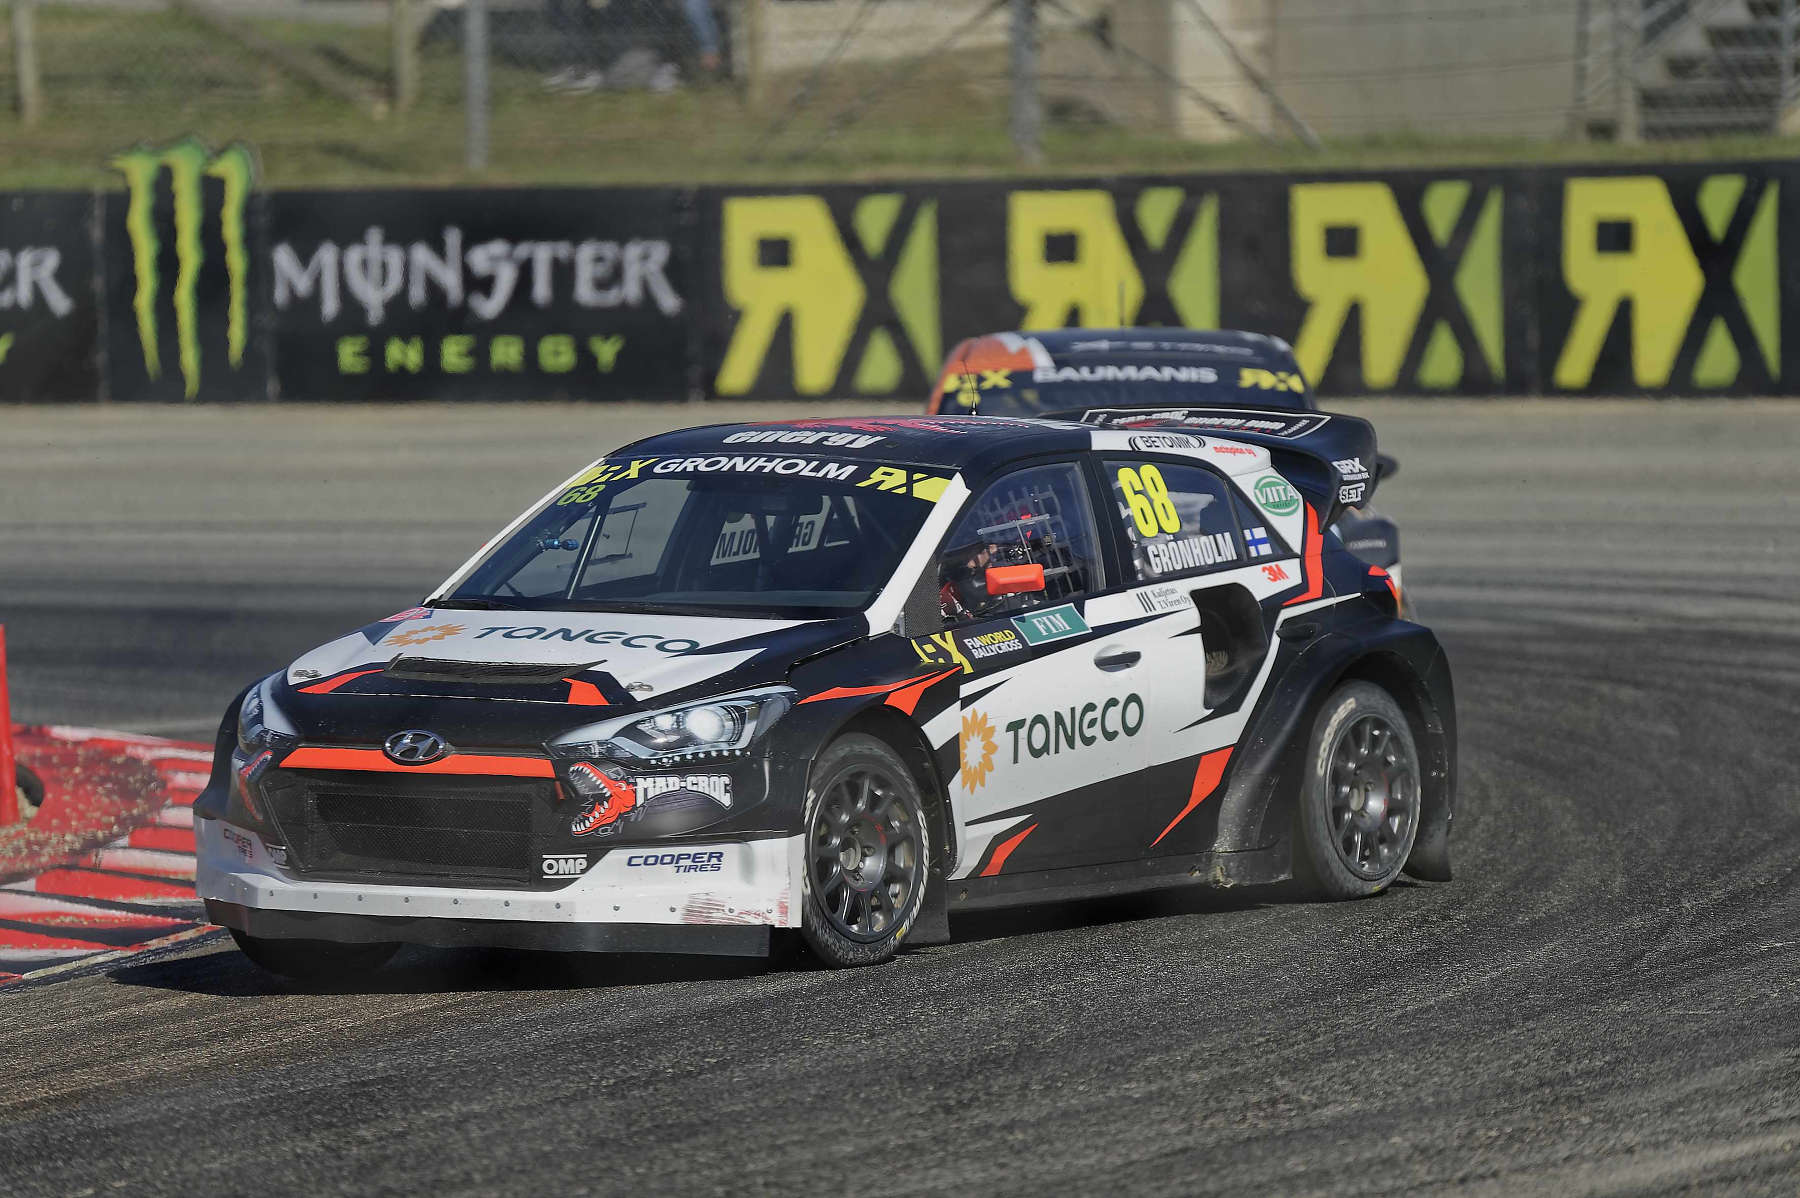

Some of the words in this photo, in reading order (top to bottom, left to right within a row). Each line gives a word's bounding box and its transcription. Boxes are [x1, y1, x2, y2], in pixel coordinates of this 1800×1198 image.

[272, 226, 682, 322] MONSTER
[336, 334, 625, 374] ENERGY
[1033, 366, 1218, 383] BAUMANIS
[723, 431, 888, 449] energy
[1143, 435, 1196, 448] BETOMIK
[653, 456, 859, 481] GRONHOLM
[556, 484, 606, 506] 68
[1118, 464, 1181, 537] 68
[1254, 484, 1299, 505] VIITA
[1262, 563, 1289, 583] 3M
[971, 638, 1023, 660] RALLYCROSS
[1005, 692, 1144, 766] TANECO
[635, 775, 733, 810] MAD-CROC
[541, 858, 588, 875] OMP
[627, 851, 725, 868] COOPER
[674, 863, 722, 874] TIRES
